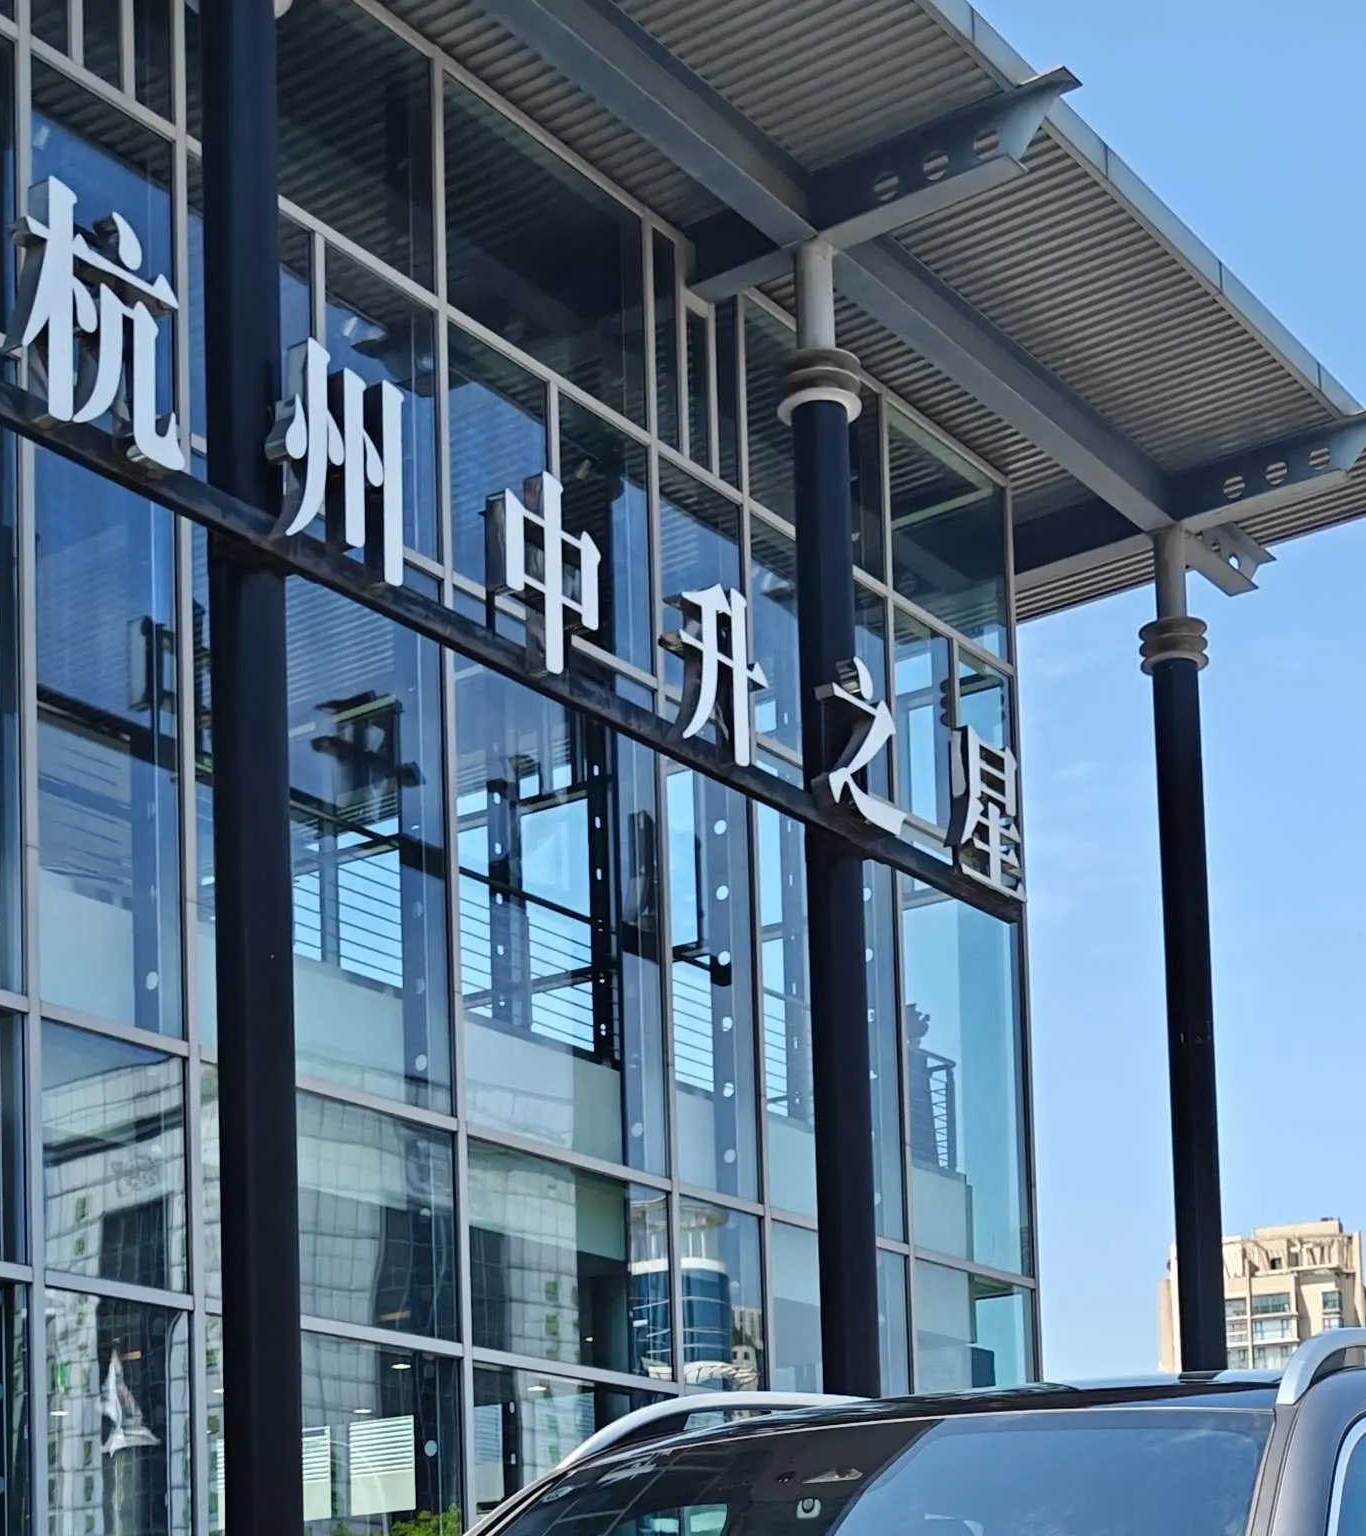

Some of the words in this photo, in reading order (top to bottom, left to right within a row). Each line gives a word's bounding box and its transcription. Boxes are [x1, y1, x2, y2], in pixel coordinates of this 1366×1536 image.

[11, 174, 1027, 902] 杭州中升之星
